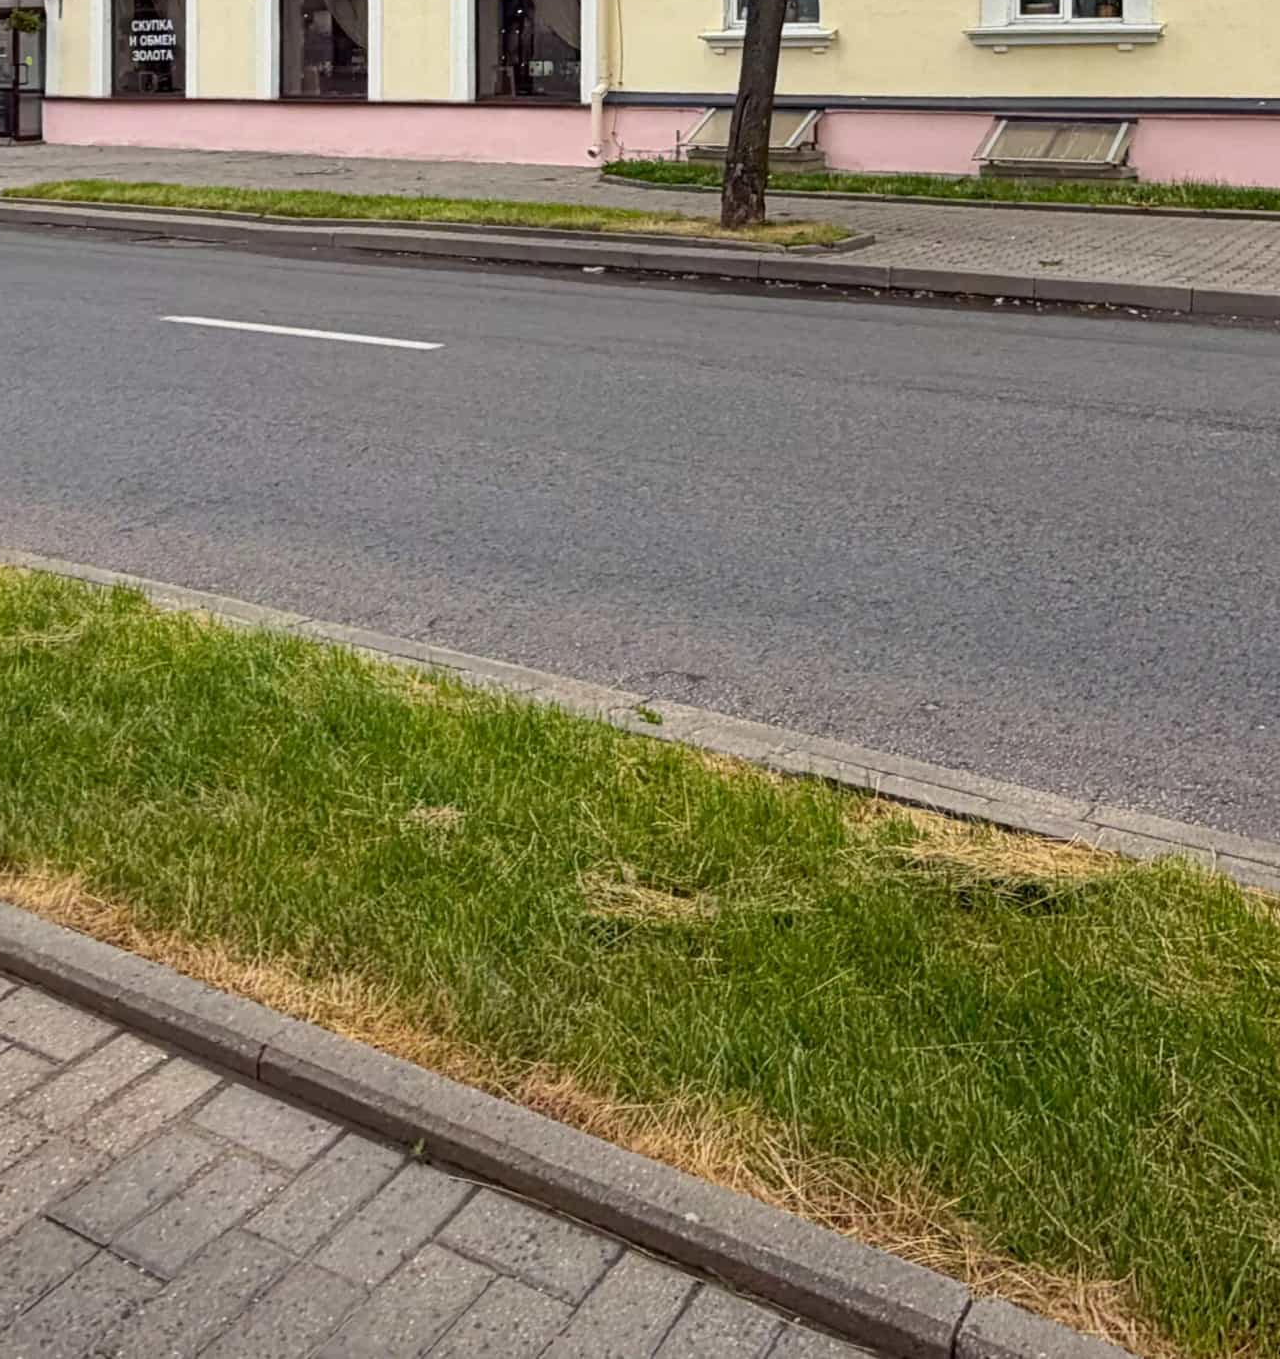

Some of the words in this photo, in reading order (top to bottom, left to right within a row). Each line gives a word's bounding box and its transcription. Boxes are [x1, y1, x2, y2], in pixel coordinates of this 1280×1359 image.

[131, 19, 174, 32] СКУПКА
[140, 34, 176, 46] ОБМЕН
[131, 50, 174, 61] ЗОЛОТА
